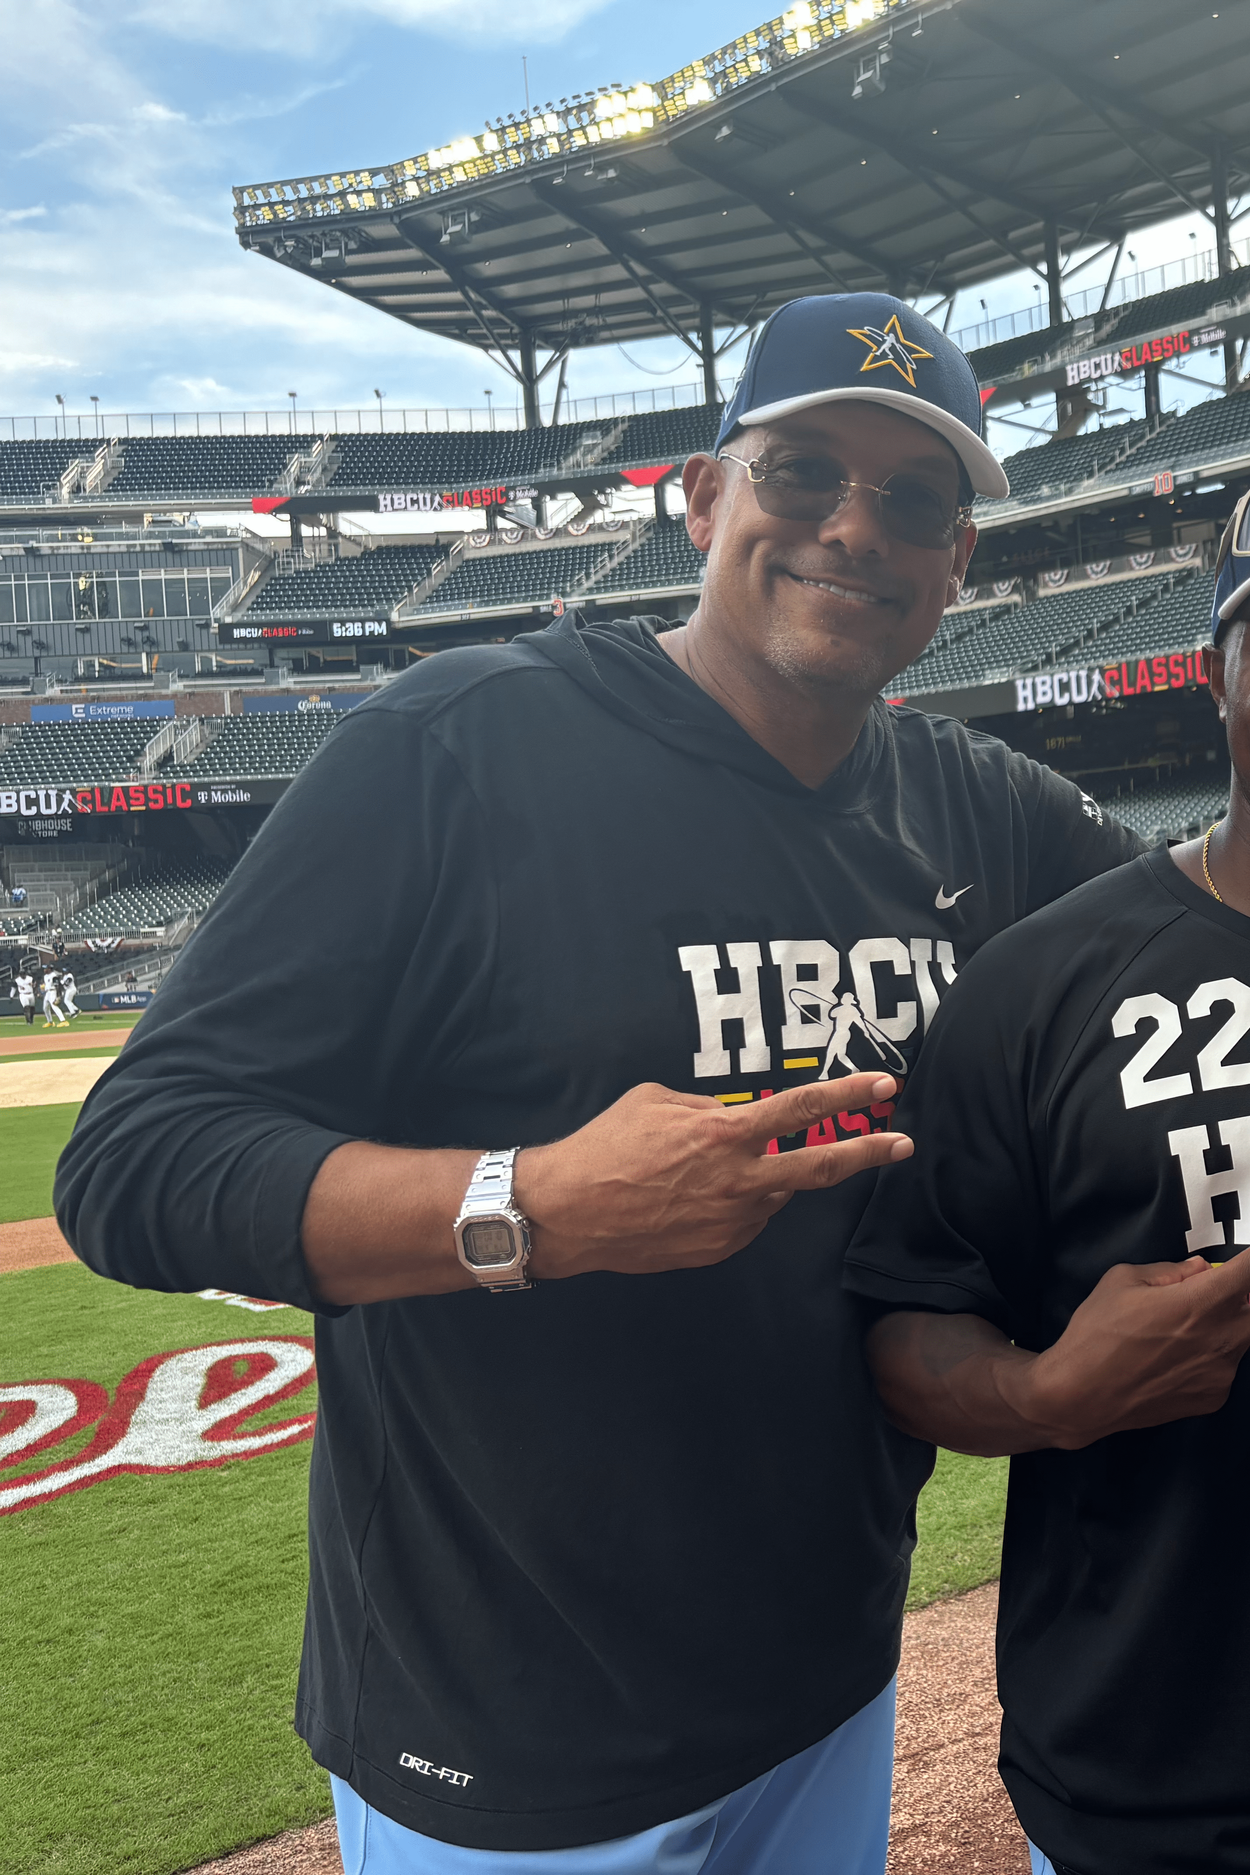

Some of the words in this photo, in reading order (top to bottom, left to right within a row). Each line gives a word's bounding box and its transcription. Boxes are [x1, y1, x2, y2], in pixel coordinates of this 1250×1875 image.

[1065, 352, 1116, 386] HBCU
[1153, 470, 1174, 497] 10
[378, 492, 433, 512] HBCU
[553, 598, 564, 617] 3
[233, 628, 258, 639] HBCU
[364, 620, 387, 636] PM
[1015, 669, 1090, 712] HBCU
[89, 704, 134, 716] Extreme
[297, 699, 332, 711] Corona
[210, 788, 251, 804] Mobile
[119, 995, 137, 1004] MLB
[399, 1752, 474, 1788] DRI-FIT
